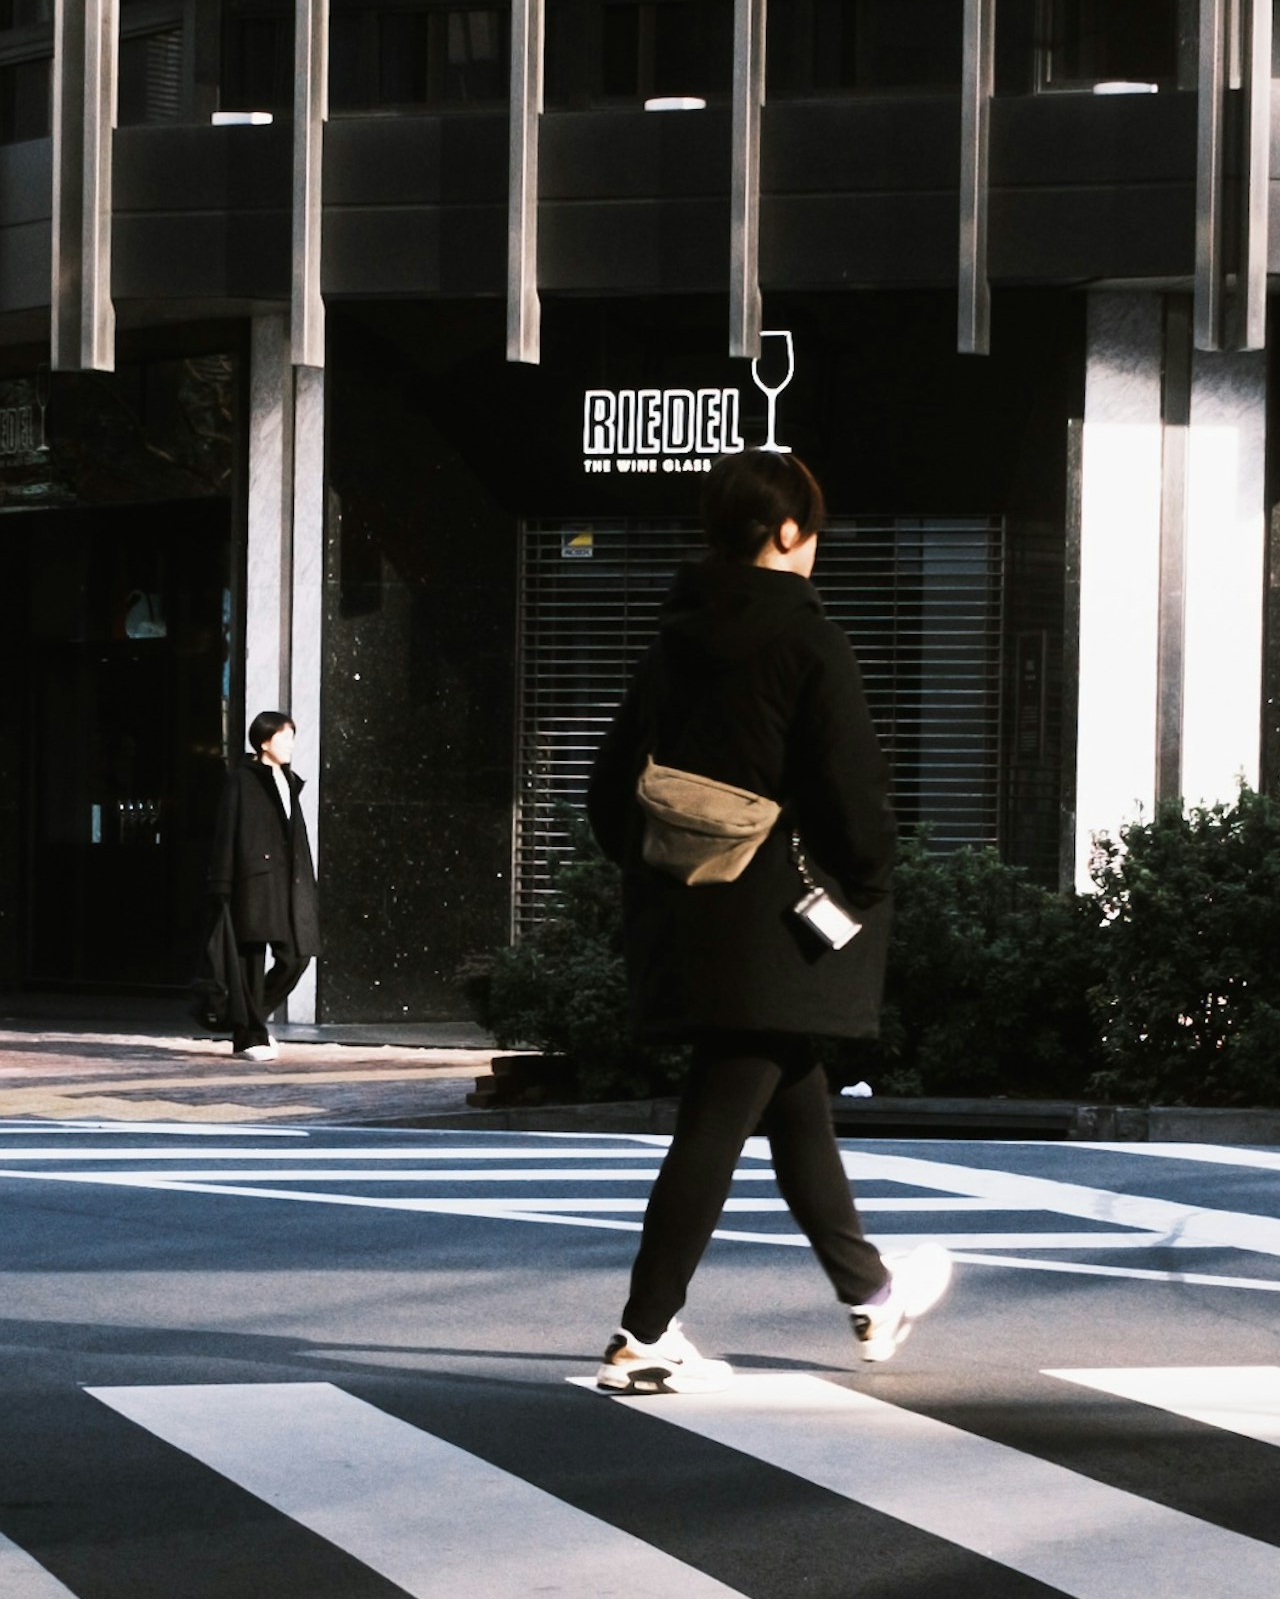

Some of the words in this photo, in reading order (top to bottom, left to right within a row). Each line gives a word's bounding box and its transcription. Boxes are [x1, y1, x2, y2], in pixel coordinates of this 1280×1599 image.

[583, 388, 744, 455] RIEDEL
[583, 459, 612, 473] THE
[616, 459, 658, 473] WINE
[662, 459, 712, 473] GLASS
